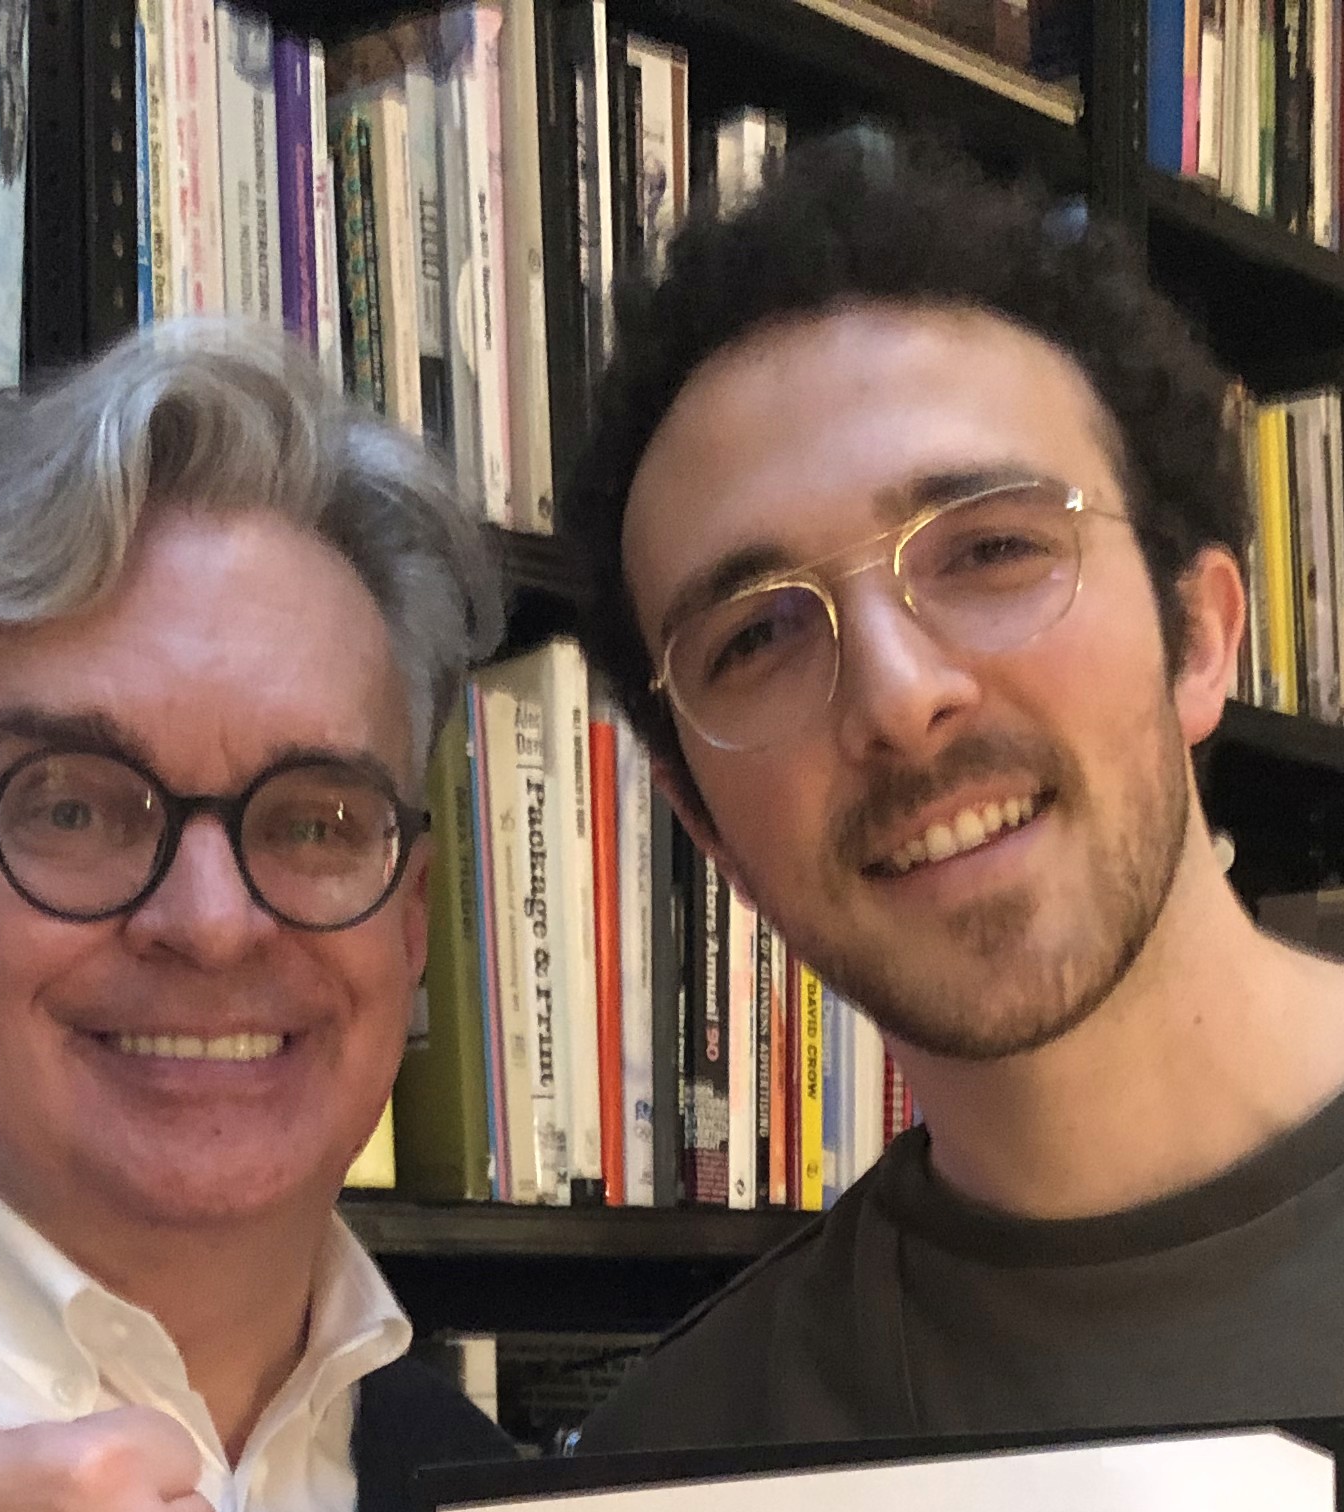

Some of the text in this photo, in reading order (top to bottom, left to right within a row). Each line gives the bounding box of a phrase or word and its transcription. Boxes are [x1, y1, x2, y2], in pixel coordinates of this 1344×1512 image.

[524, 778, 555, 1087] Package & Print
[706, 939, 719, 1021] Annual
[706, 1026, 719, 1062] 90
[807, 983, 818, 1100] DAVID CROW
[759, 1043, 769, 1138] ADVERTISING
